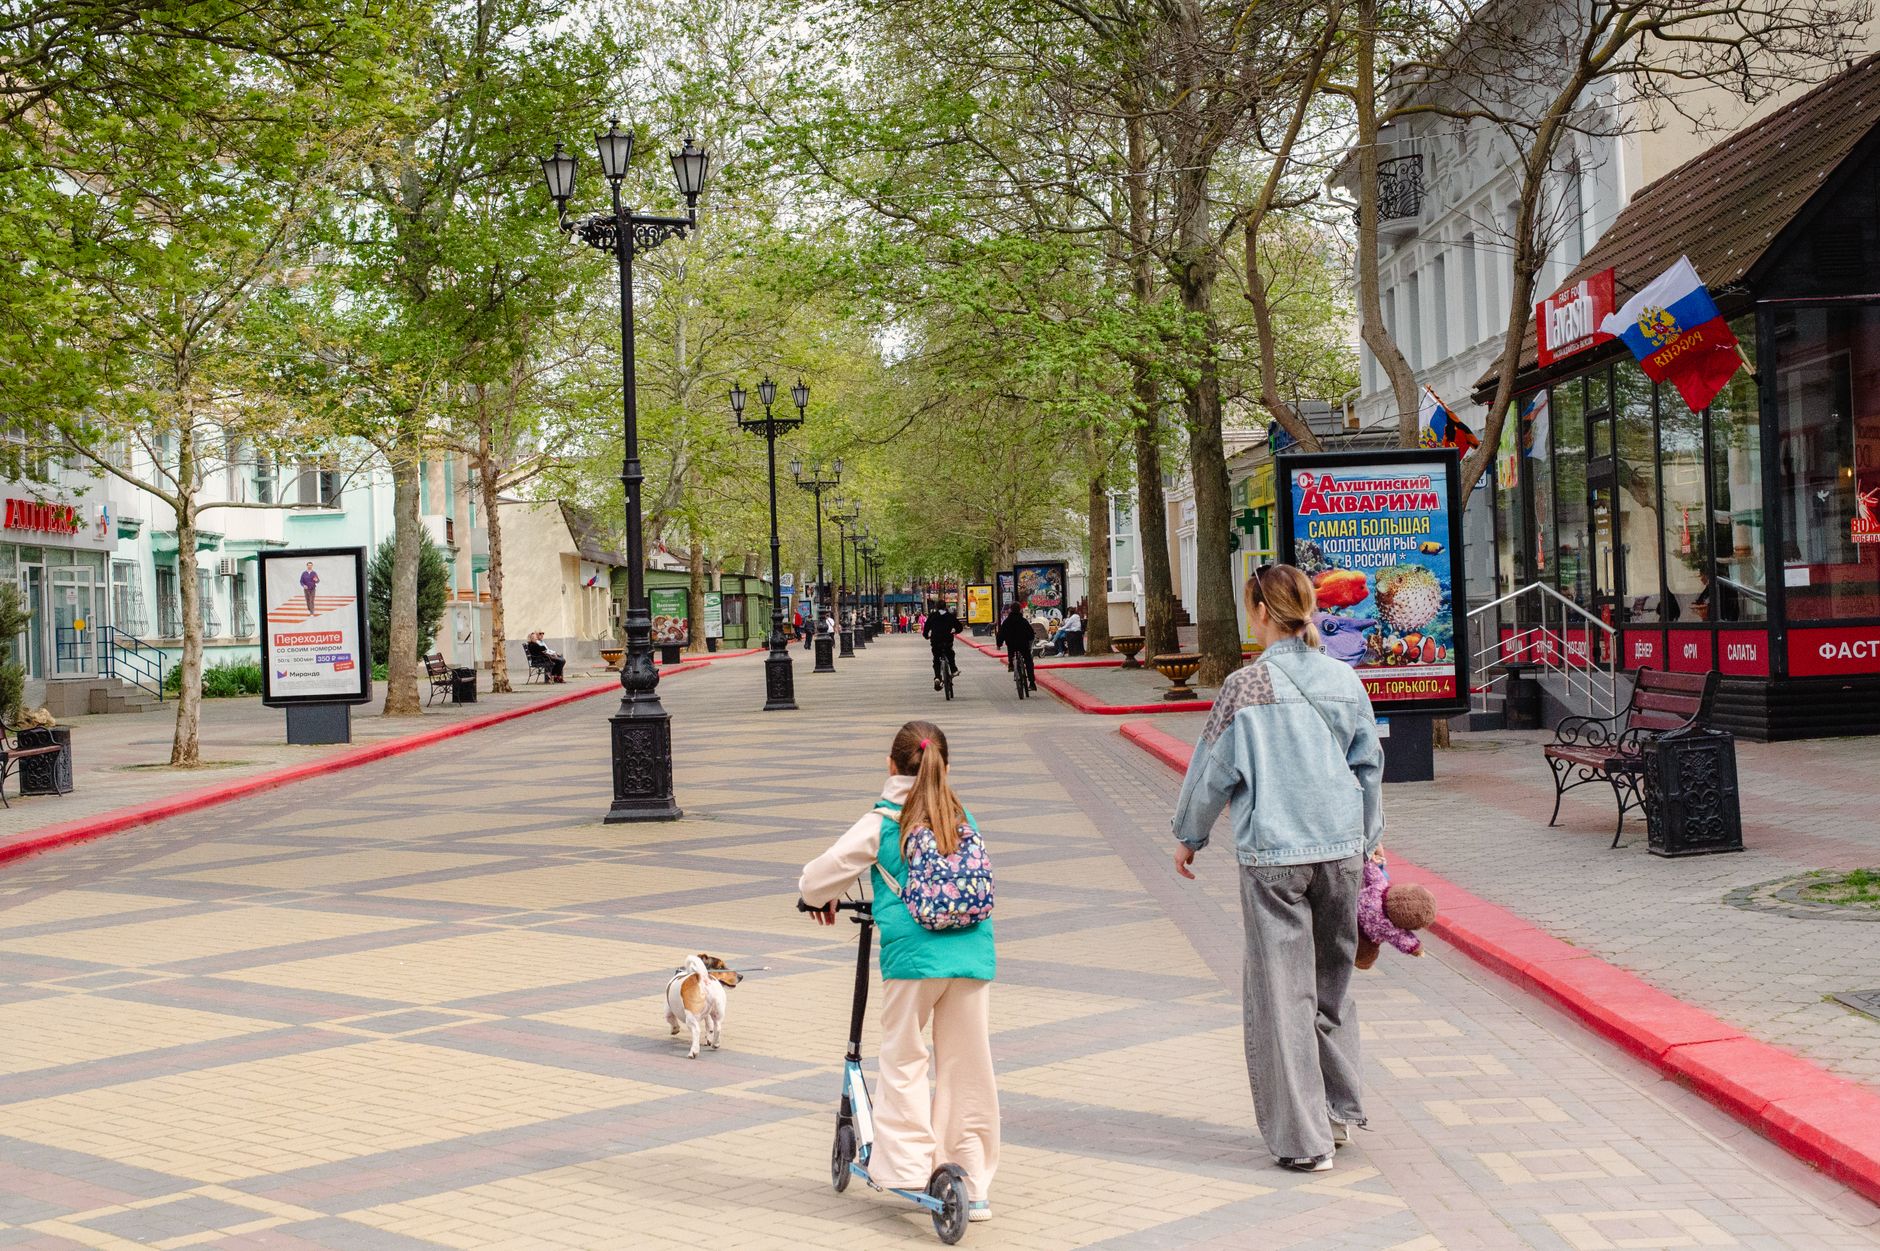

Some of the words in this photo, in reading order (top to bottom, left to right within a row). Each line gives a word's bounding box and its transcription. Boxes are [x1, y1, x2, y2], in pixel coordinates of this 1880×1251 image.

[1558, 289, 1570, 304] FAST
[1545, 280, 1594, 351] Lavash
[1308, 519, 1357, 538] САМАЯ
[1361, 517, 1430, 536] БОЛЬШАЯ
[1851, 518, 1869, 533] 80
[1323, 538, 1391, 553] КОЛЛЕКЦИЯ
[1393, 536, 1417, 550] РЫБ
[1851, 534, 1880, 544] ПОБЕДА
[1345, 556, 1352, 568] В
[1355, 553, 1397, 567] РОССИИ
[276, 634, 341, 645] Переходите
[1683, 643, 1698, 659] ФРИ
[1727, 644, 1757, 661] САЛАТЫ
[1818, 640, 1880, 660] ФАСТ
[1366, 682, 1383, 694] УЛ.
[1386, 680, 1441, 693] ГОРЬКОГО,
[1443, 680, 1450, 691] 4
